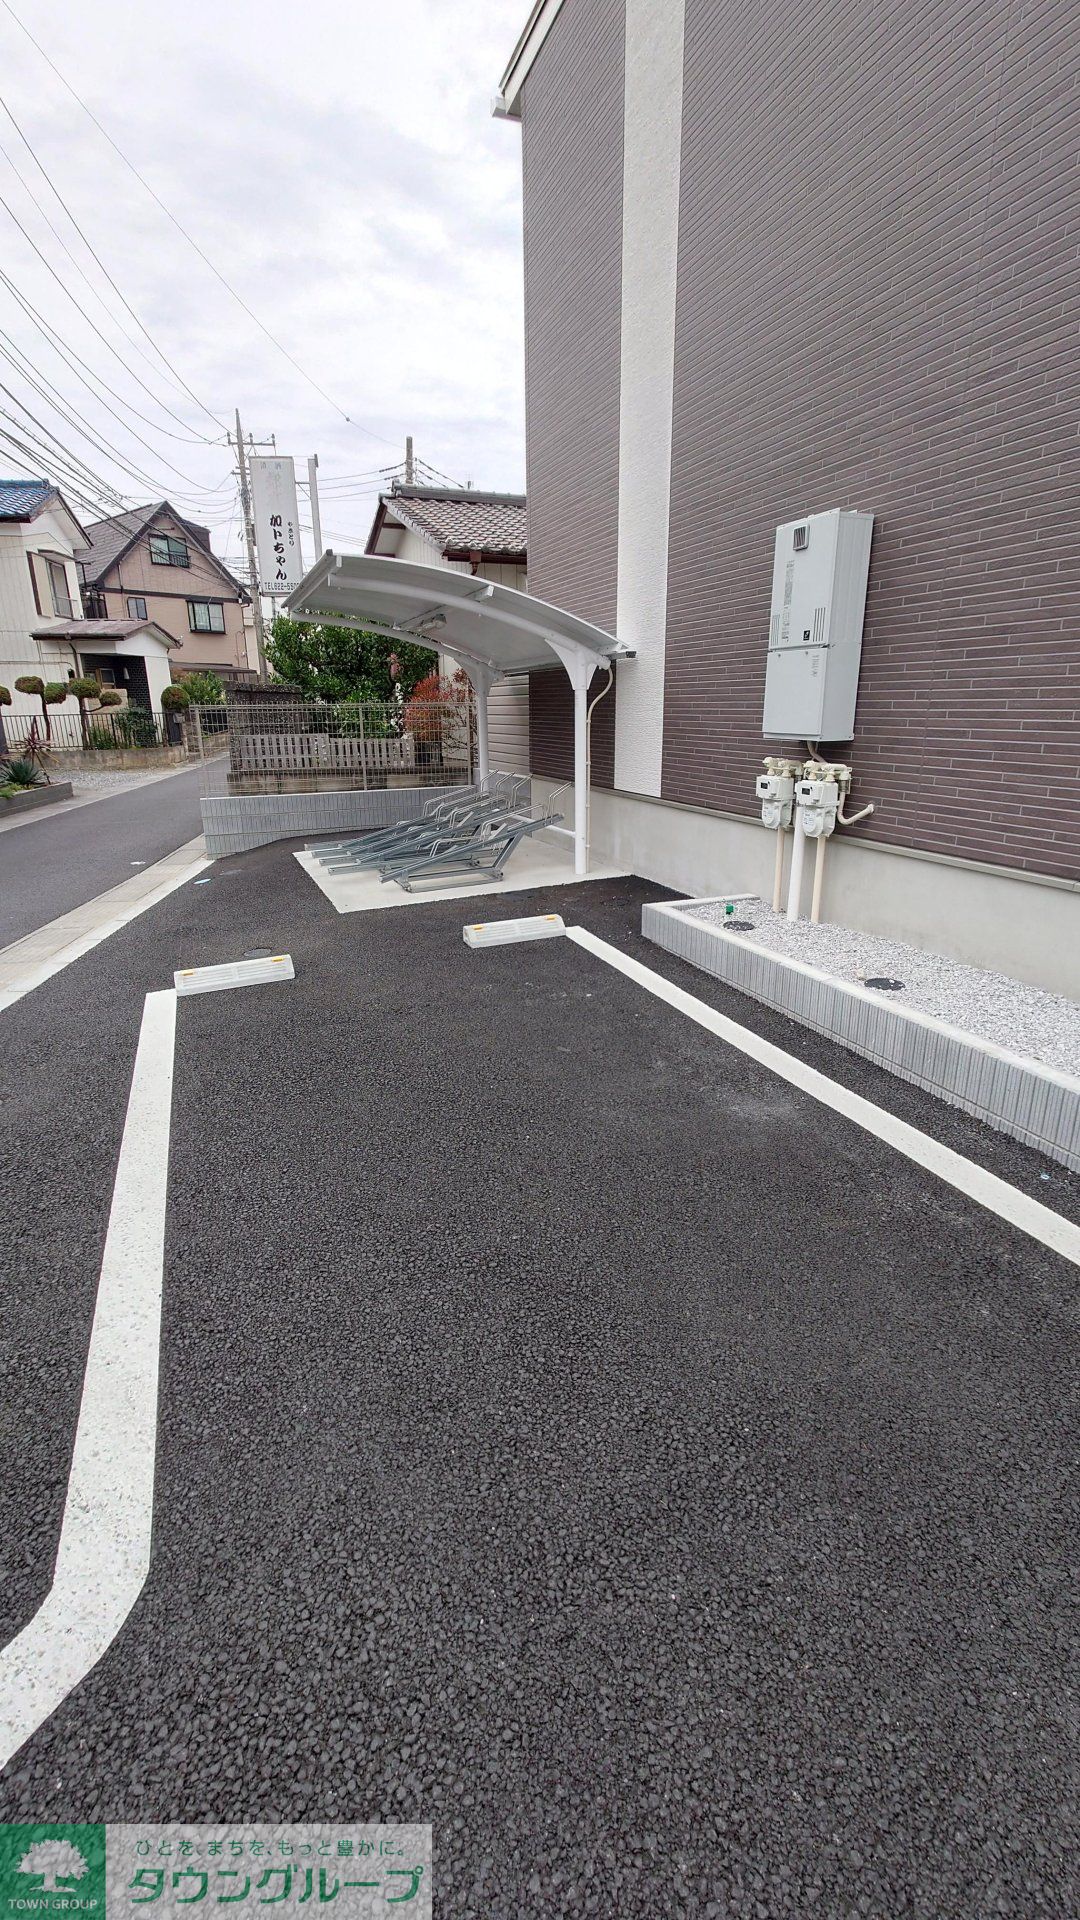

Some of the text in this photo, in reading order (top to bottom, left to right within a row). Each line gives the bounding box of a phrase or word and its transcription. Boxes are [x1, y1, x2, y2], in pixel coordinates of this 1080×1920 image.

[270, 514, 287, 580] 加トちゃん
